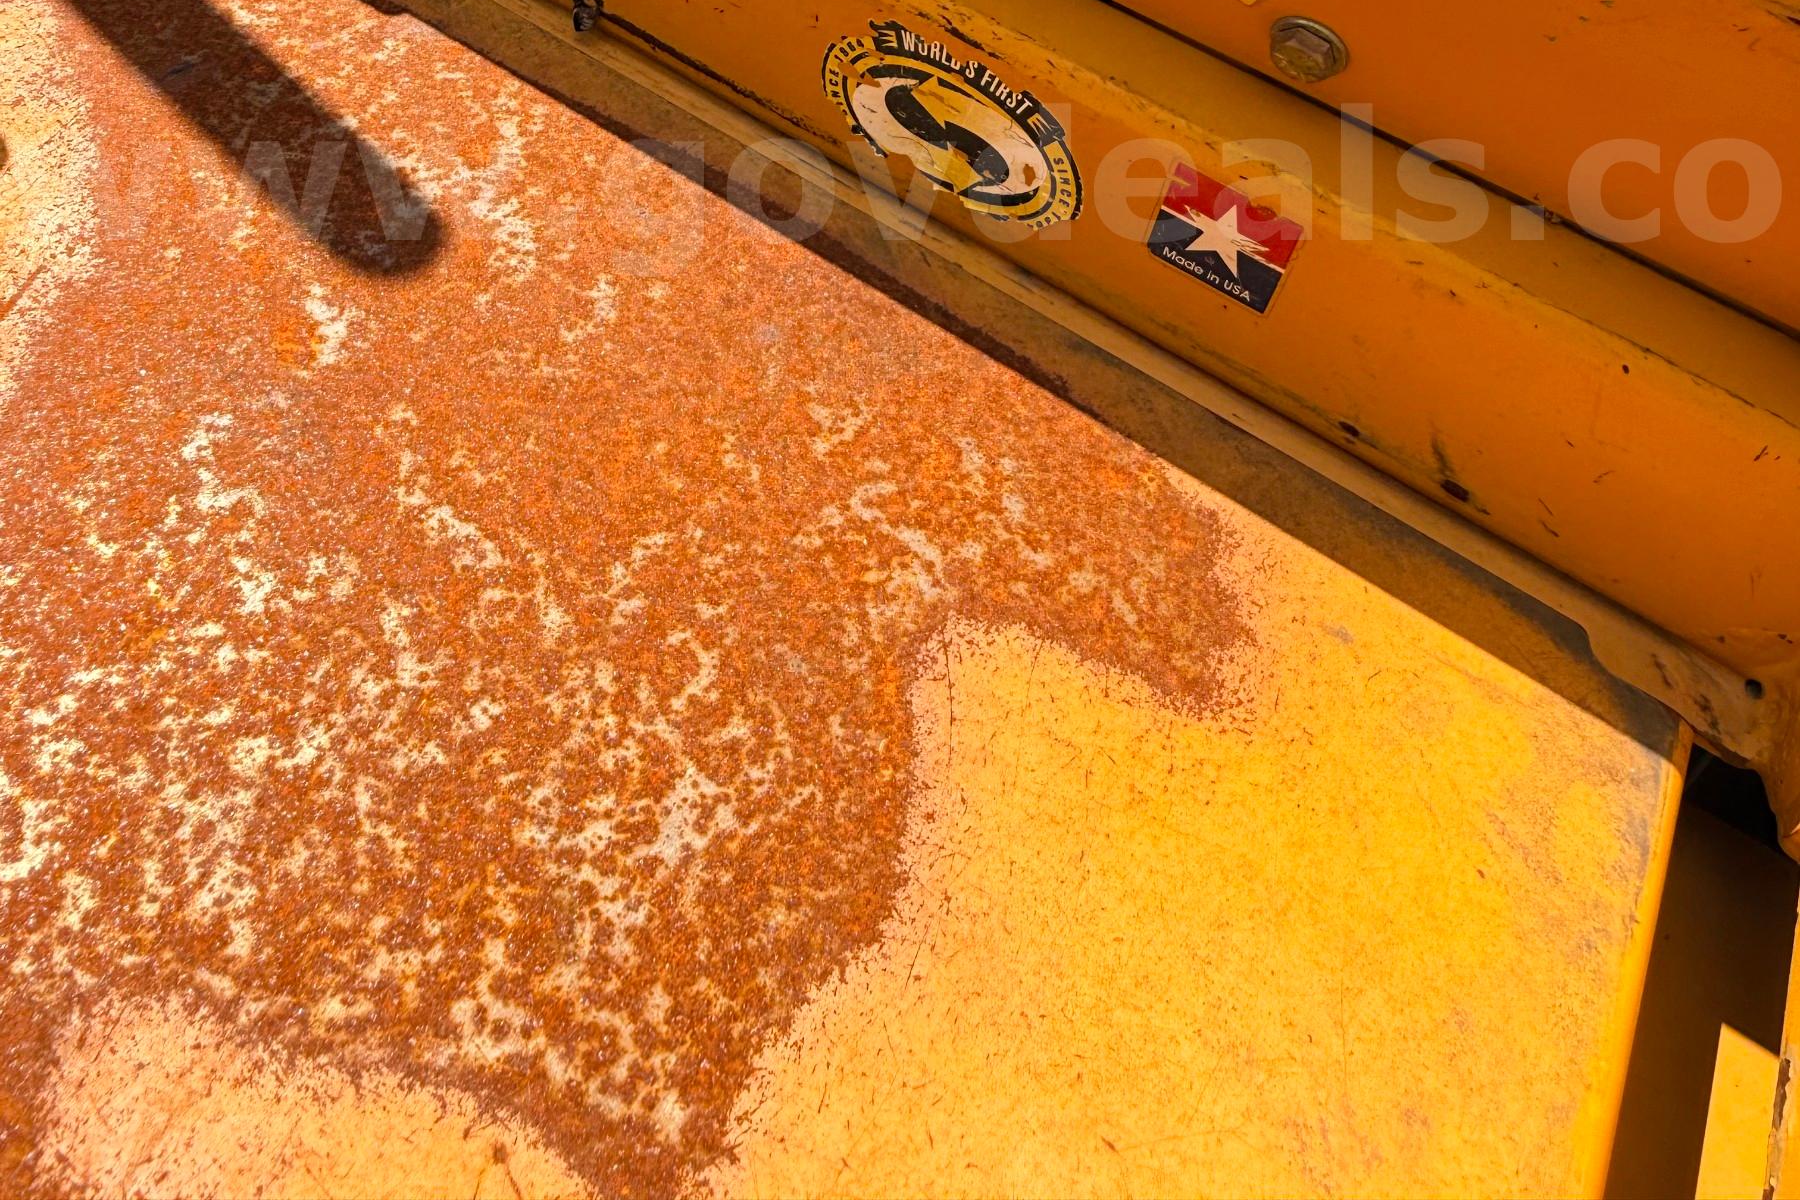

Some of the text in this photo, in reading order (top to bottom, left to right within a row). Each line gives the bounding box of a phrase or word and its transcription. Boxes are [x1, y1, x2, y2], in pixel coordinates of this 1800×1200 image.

[981, 69, 1033, 115] FIRST
[1162, 246, 1250, 302] Made in USA
